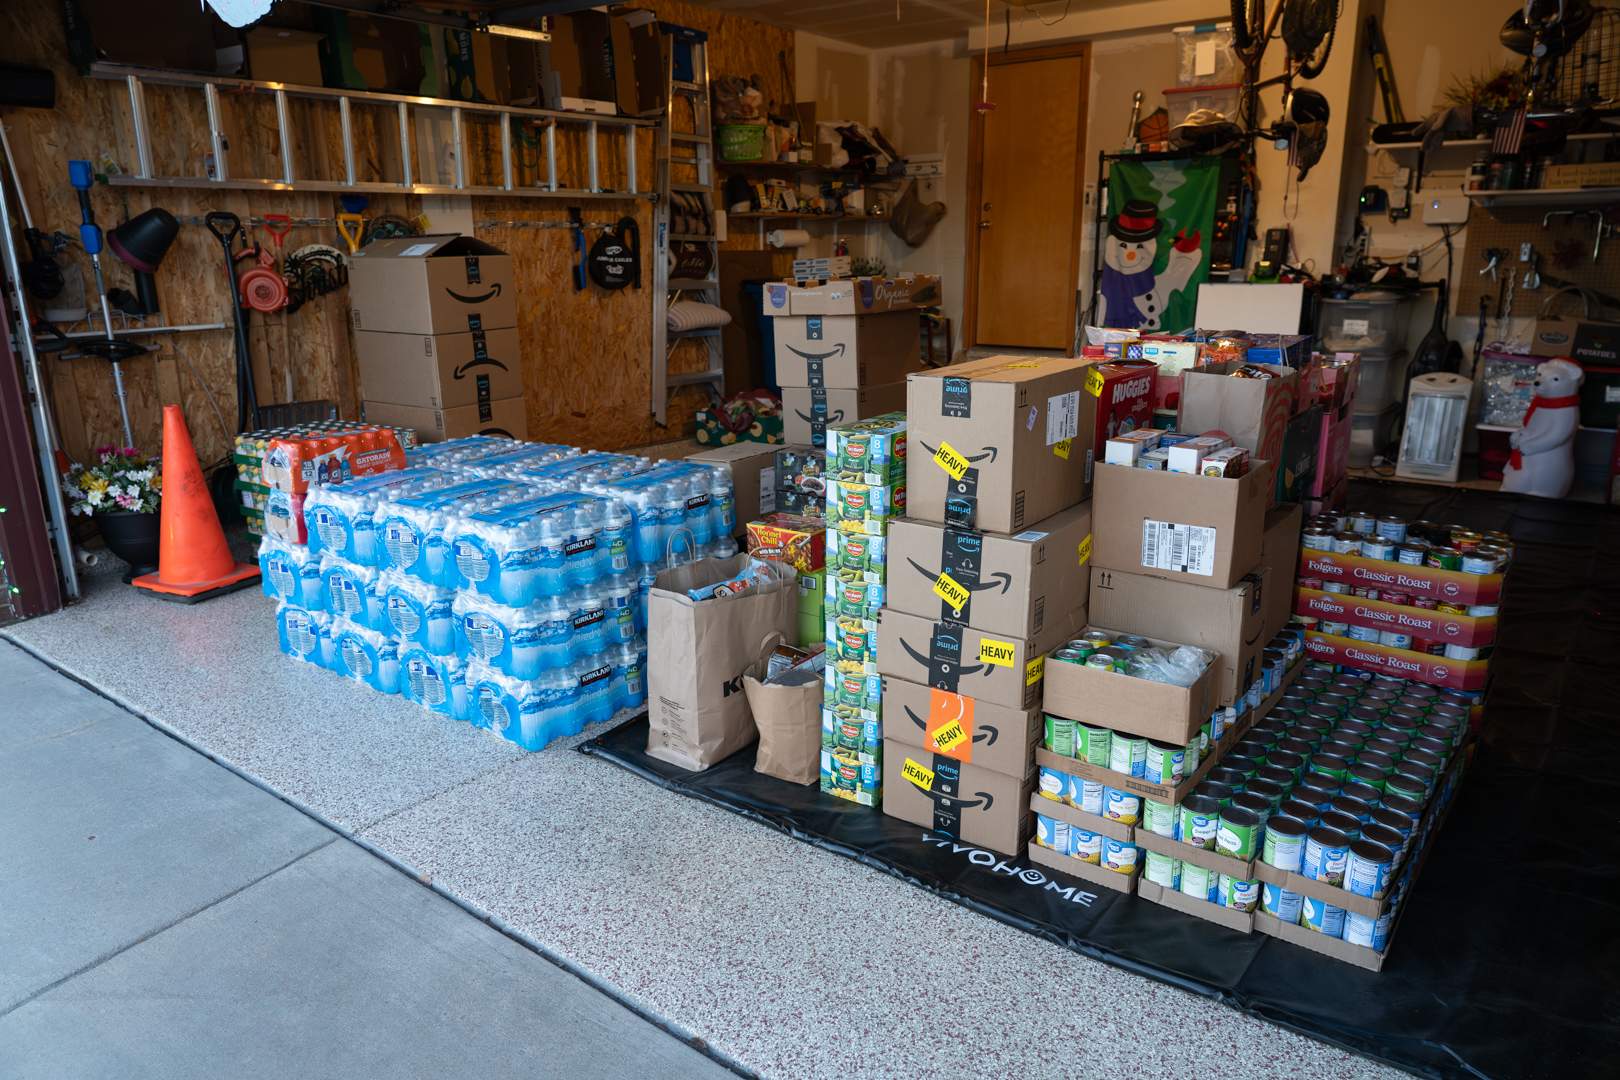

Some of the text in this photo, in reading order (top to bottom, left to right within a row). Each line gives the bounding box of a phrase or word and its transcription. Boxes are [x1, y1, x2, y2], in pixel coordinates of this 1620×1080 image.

[946, 385, 968, 395] prime
[1112, 375, 1152, 405] HUGGIES
[874, 440, 881, 449] 8
[356, 450, 391, 466] GATORADE
[936, 447, 966, 475] HEAVY
[874, 491, 881, 500] 8
[948, 504, 971, 515] prime
[872, 540, 879, 549] 8
[957, 535, 980, 546] prime
[1308, 559, 1344, 575] Folgers
[1353, 567, 1394, 583] Classic
[1397, 574, 1432, 590] Roast
[871, 587, 878, 596] 8
[936, 579, 967, 605] HEAVY
[1309, 599, 1433, 629] Folgers Classic Roast
[936, 640, 959, 651] prime
[981, 645, 1014, 660] HEAVY
[1345, 647, 1385, 664] Classic
[1387, 656, 1421, 672] Roast
[1027, 663, 1044, 680] HEAV
[867, 725, 874, 734] 8
[935, 724, 963, 747] HEAVY
[865, 767, 871, 775] 8
[903, 763, 933, 785] HEAVY
[937, 763, 959, 775] prime
